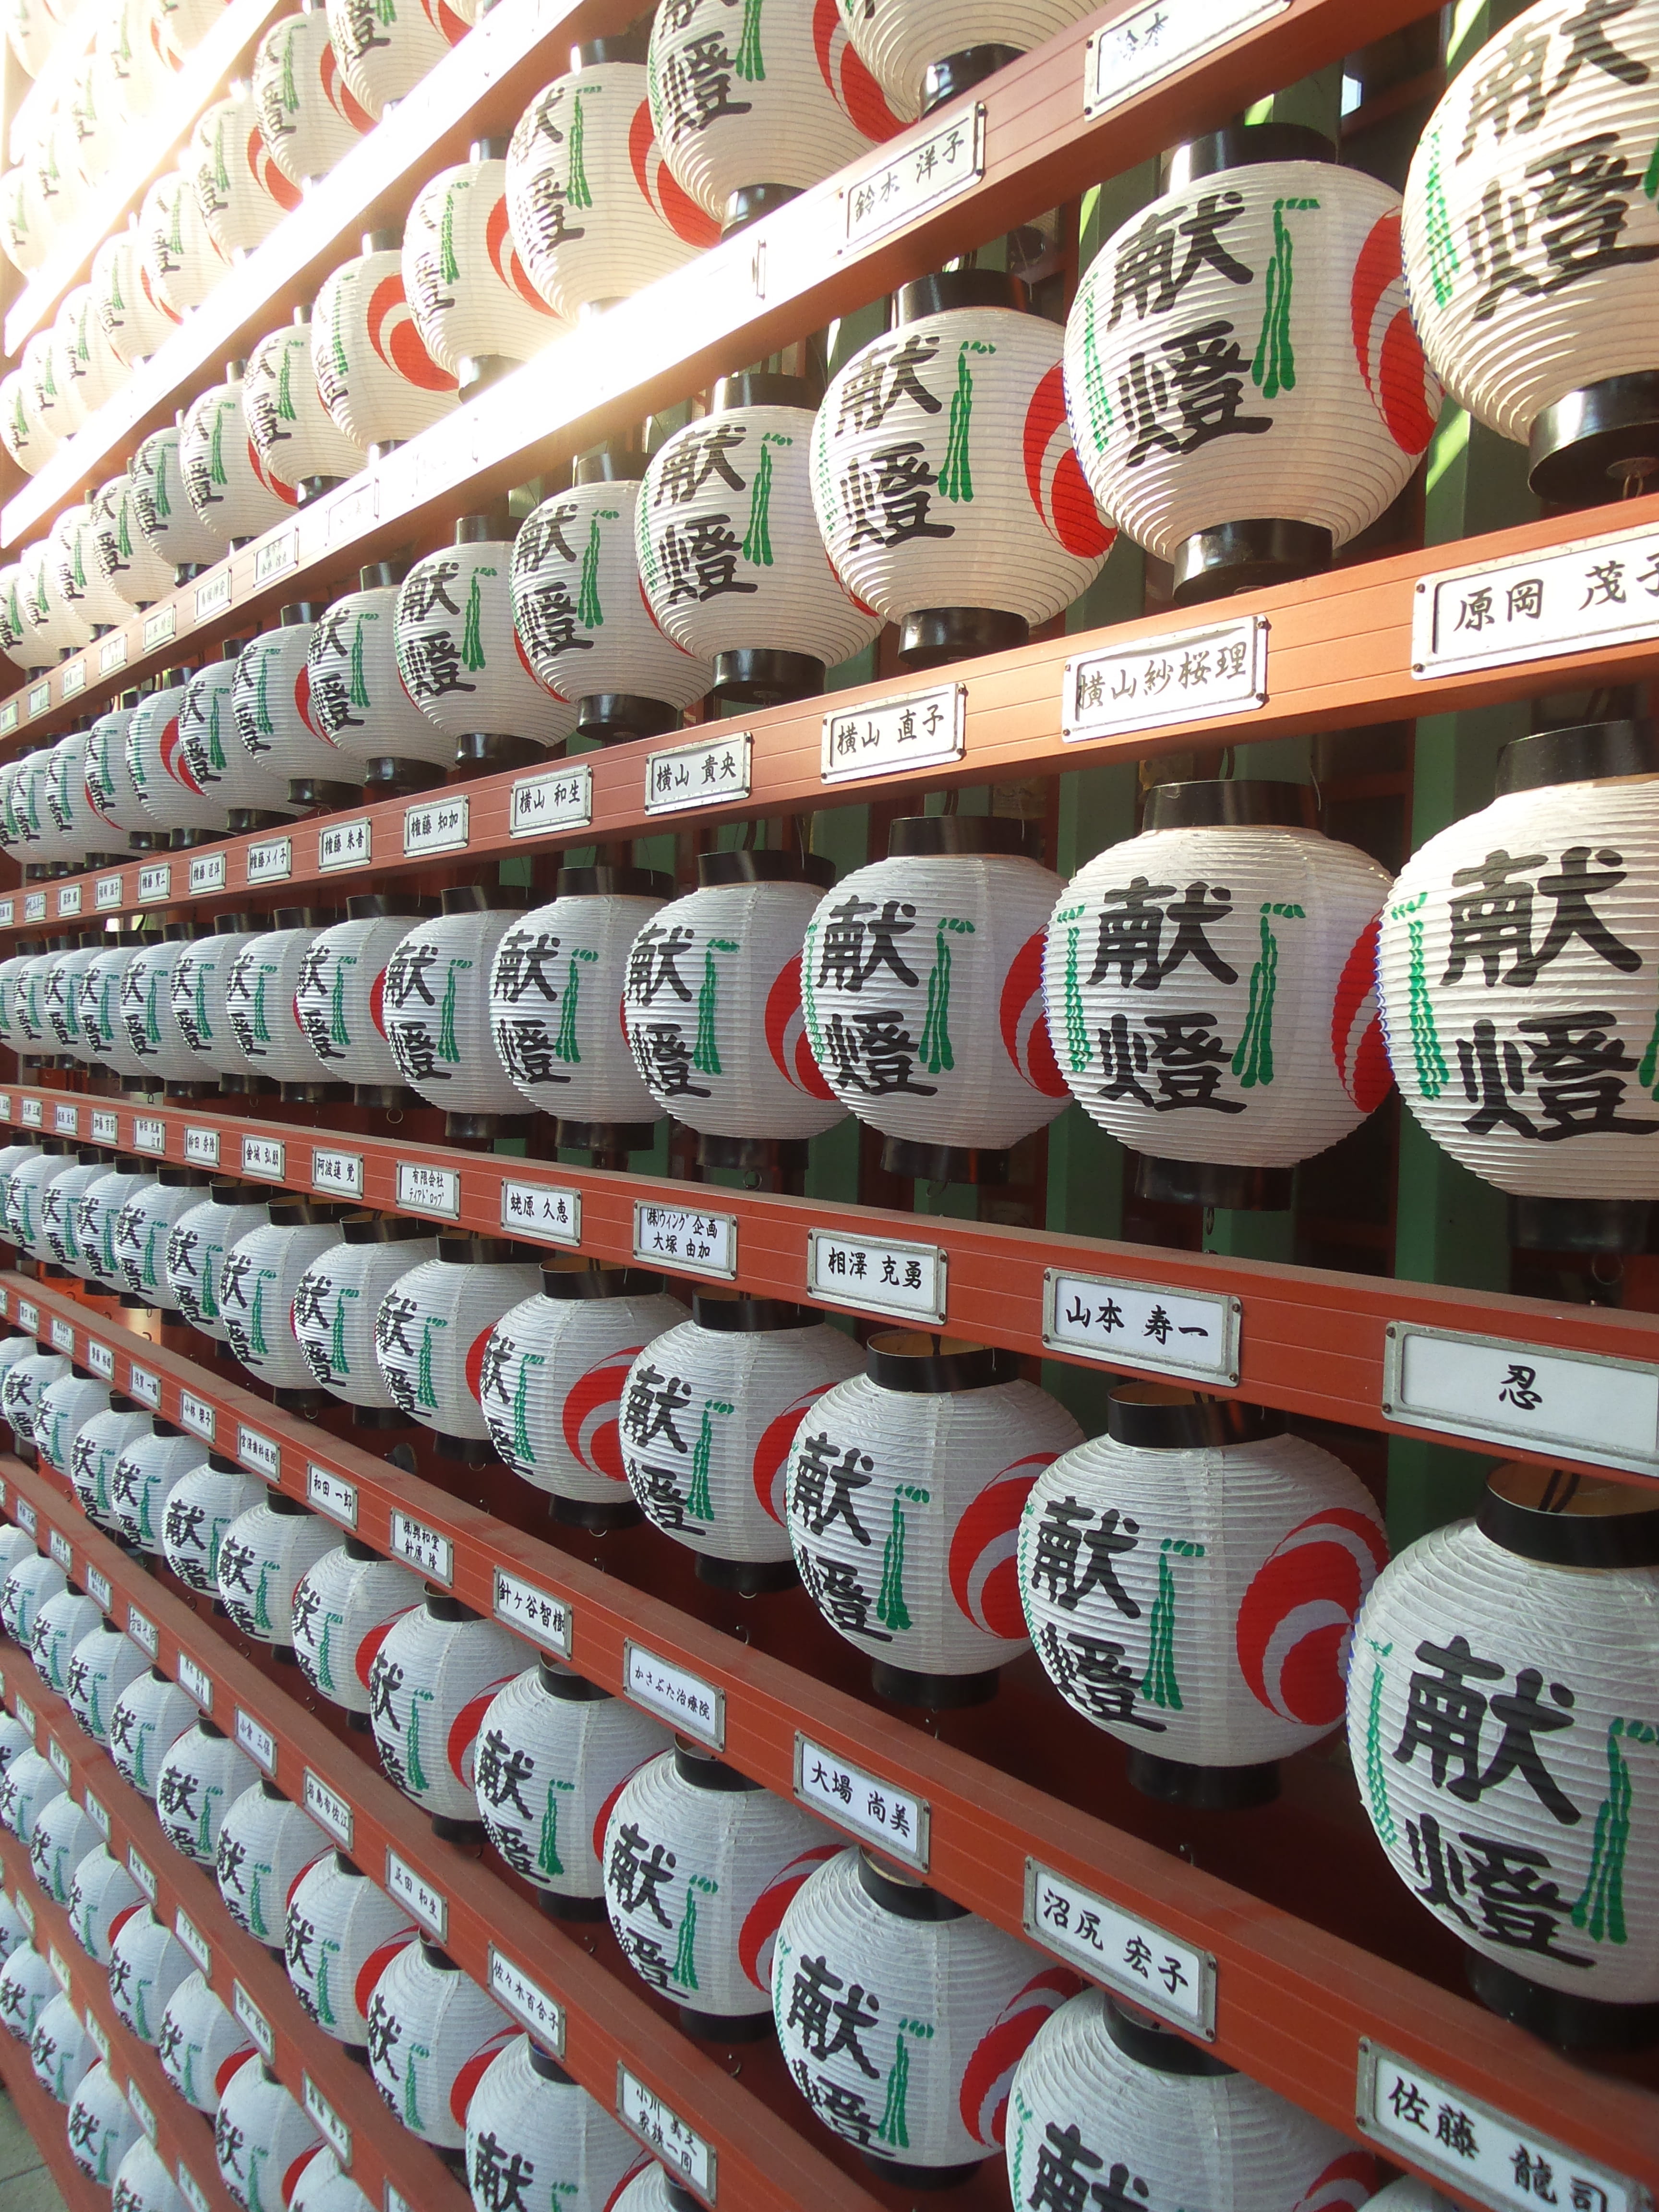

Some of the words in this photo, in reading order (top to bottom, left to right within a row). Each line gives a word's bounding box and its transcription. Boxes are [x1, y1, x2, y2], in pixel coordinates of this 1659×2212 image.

[916, 132, 964, 184] 洋子
[1108, 192, 1273, 468] 献燈
[838, 335, 955, 551] 献燈
[654, 425, 758, 604] 献燈
[515, 504, 594, 661] 献燈
[1454, 579, 1544, 631] 原岡
[397, 562, 476, 699] 献燈
[1078, 641, 1247, 709] 横山紗桜理
[837, 721, 880, 756] 横山
[898, 704, 945, 745] 直子
[520, 788, 545, 814] 横山
[554, 779, 580, 807] 和生
[656, 762, 690, 792] 横山
[701, 751, 736, 784] 貴央
[347, 828, 364, 850] 朱音
[411, 812, 431, 838] 権藤
[438, 809, 459, 833] 知加
[384, 941, 452, 1080] 献燈
[492, 929, 571, 1083] 献燈
[624, 923, 711, 1097] 献燈
[817, 895, 937, 1095] 献燈
[1086, 877, 1247, 1112] 献燈
[1440, 846, 1659, 1142] 献燈
[188, 1135, 200, 1151] 柳田
[246, 1143, 261, 1163] 金城
[347, 1163, 354, 1182] 覚
[412, 1168, 444, 1188] 有限会社
[543, 1198, 568, 1224] 久恵
[653, 1231, 677, 1254] 大塚
[686, 1238, 710, 1259] 由加
[829, 1246, 868, 1281] 相澤
[879, 1255, 922, 1289] 克勇
[1066, 1296, 1124, 1333] 山本
[1144, 1304, 1208, 1345] 寿一
[184, 1400, 195, 1419] 小林
[1499, 1364, 1542, 1410] 忍
[624, 1364, 706, 1535] 献燈
[314, 1474, 330, 1497] 和田
[335, 1488, 351, 1512] 一郎
[792, 1431, 893, 1642] 献燈
[1032, 1496, 1167, 1732] 献燈
[635, 1666, 710, 1721] かさぶた治療院
[810, 1760, 852, 1804] 大場
[867, 1790, 910, 1839] 尚美
[1392, 1636, 1597, 1967] 献燈
[395, 1866, 412, 1894] 正田
[608, 1823, 690, 1999] 献燈
[1044, 1888, 1104, 1951] 沼尻
[1123, 1936, 1189, 1995] 宏子
[493, 1960, 558, 2031] 佐々木百合子
[787, 1955, 895, 2157] 献燈
[1389, 2076, 1480, 2160] 佐藤
